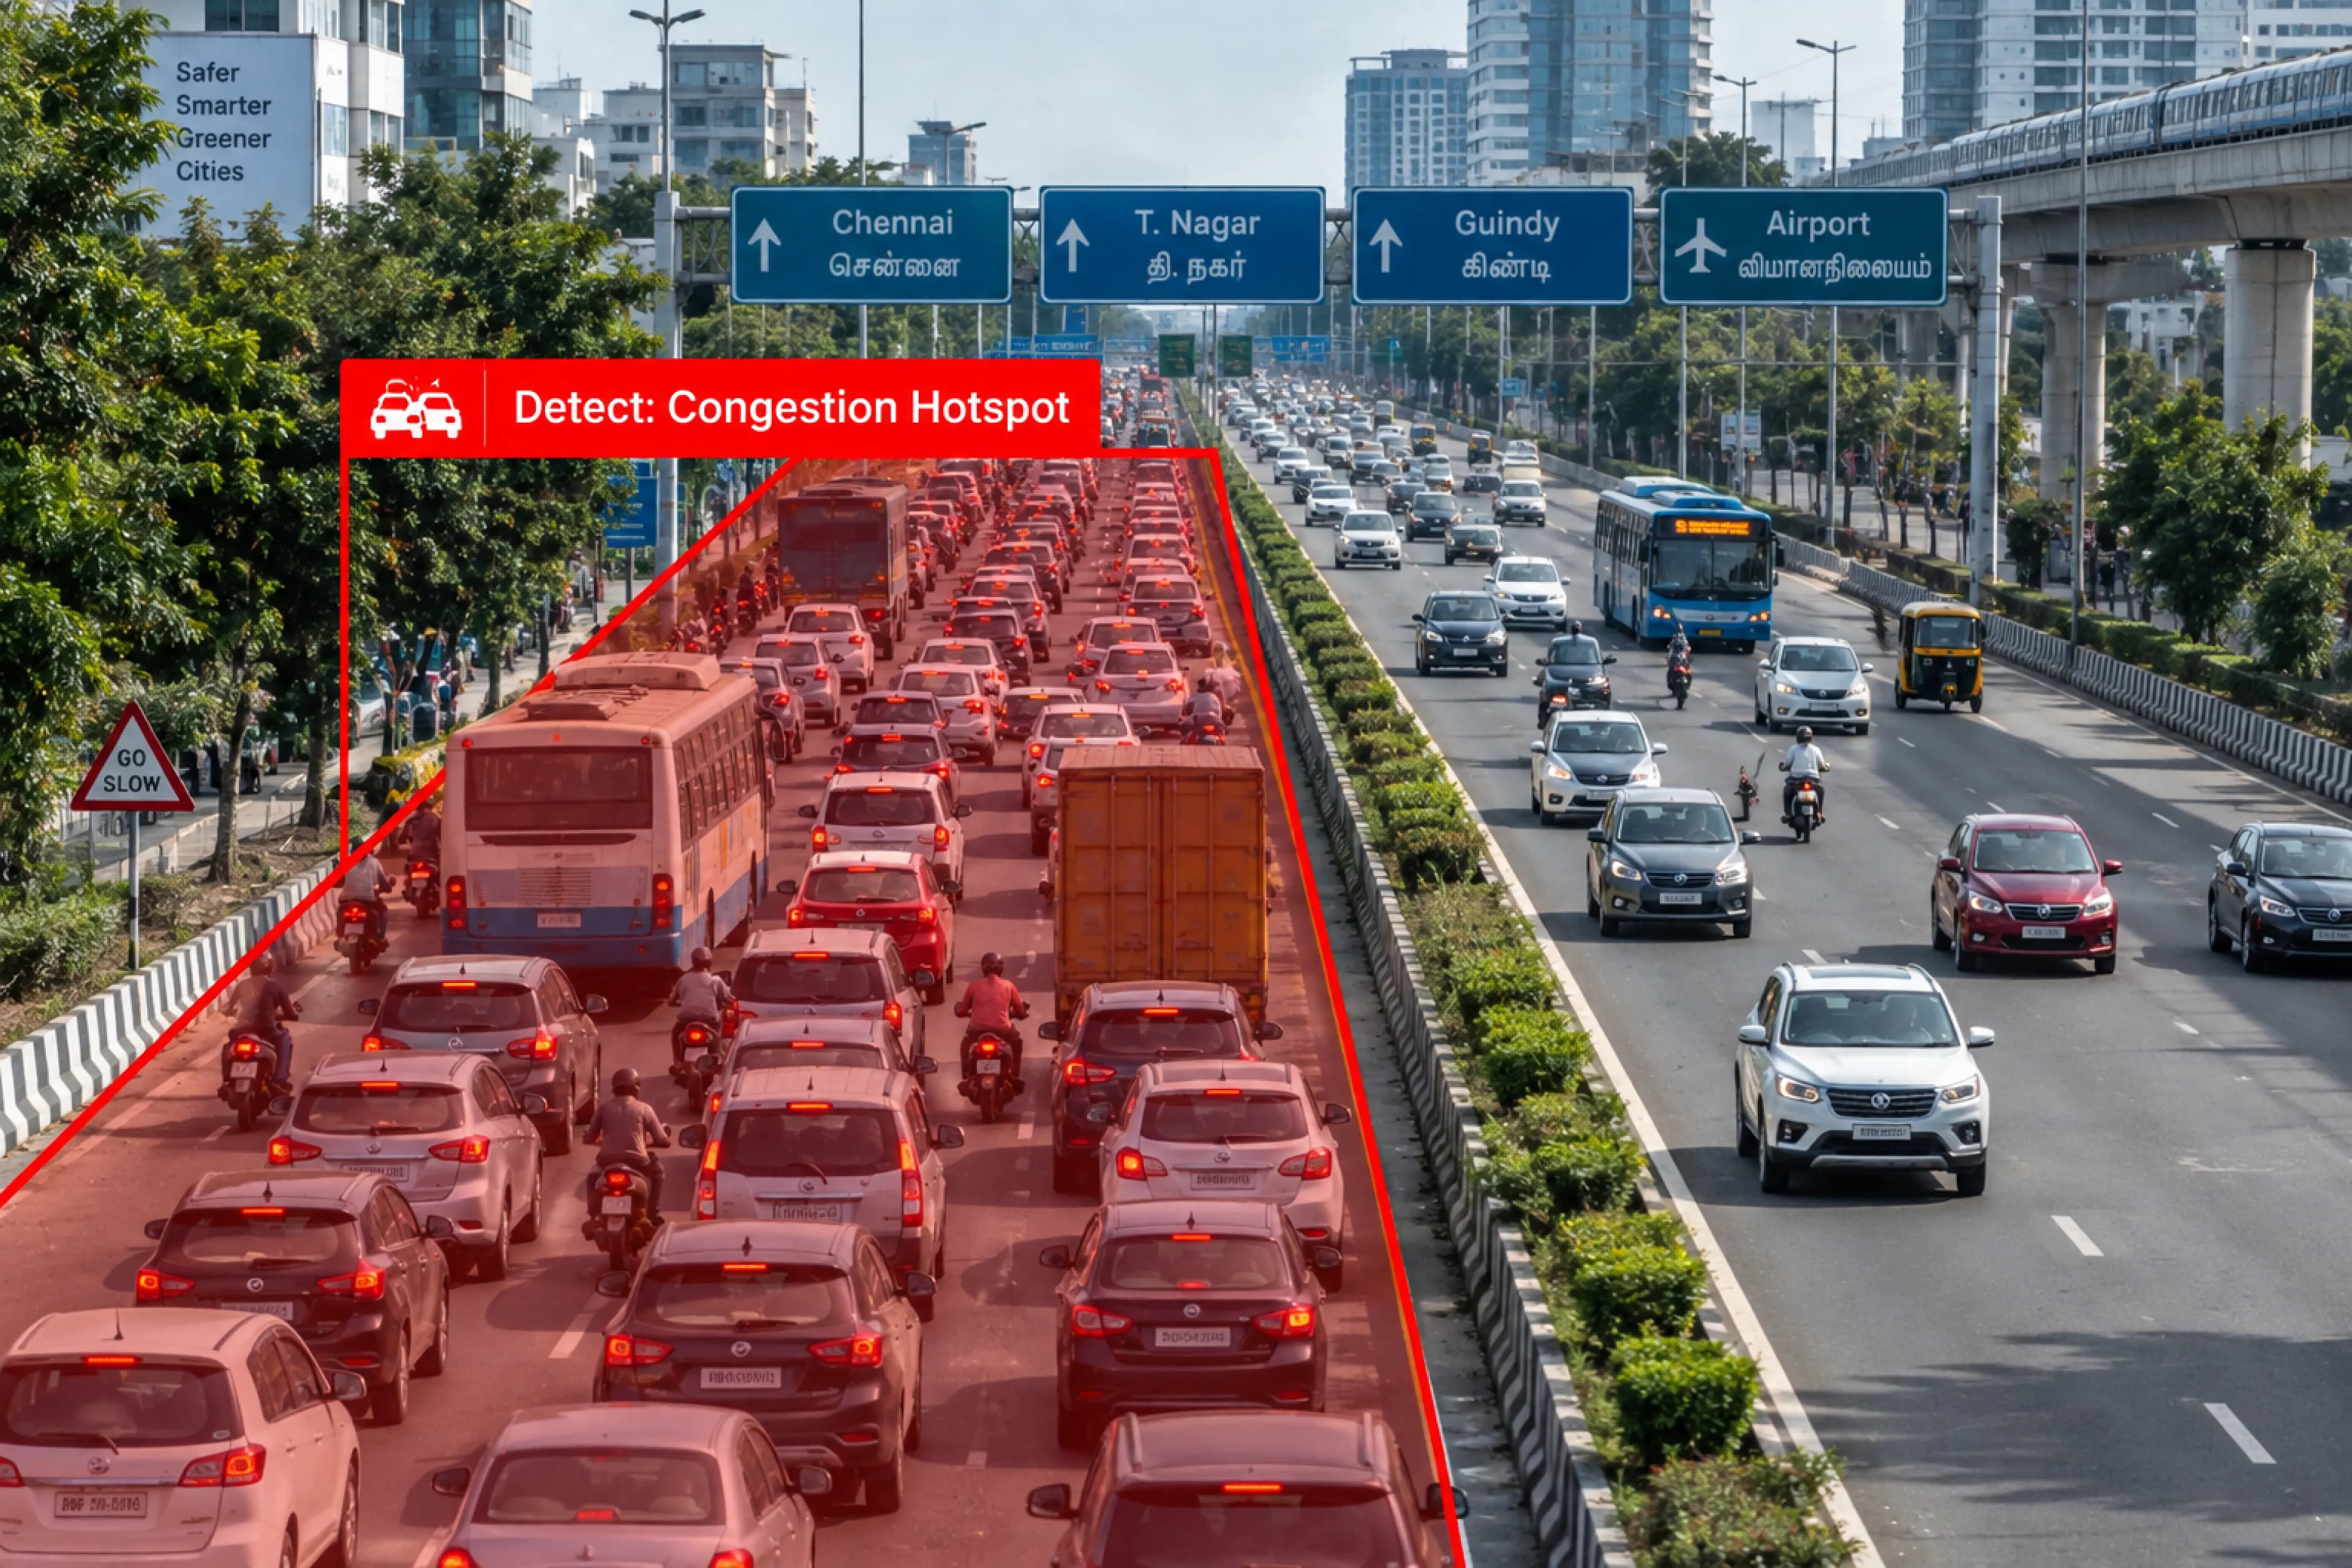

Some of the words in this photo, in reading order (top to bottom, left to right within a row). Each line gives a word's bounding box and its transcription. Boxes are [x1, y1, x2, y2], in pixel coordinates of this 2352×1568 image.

[177, 61, 240, 83] Safer
[178, 95, 271, 115] Smarter
[179, 127, 271, 148] Greener
[176, 160, 244, 181] Cities
[833, 209, 952, 235] Chennai
[1134, 209, 1159, 235] T.
[1172, 209, 1261, 242] Nagar
[1456, 209, 1559, 242] Guindy
[1767, 210, 1870, 243] Airport
[830, 251, 960, 277] சென்னை
[1147, 251, 1177, 284] தி.
[1187, 250, 1246, 285] நகர்
[1462, 251, 1551, 283] கிண்டி
[1740, 252, 1931, 285] விமானநிலையம்
[118, 749, 145, 766] GO
[104, 775, 160, 792] SLOW
